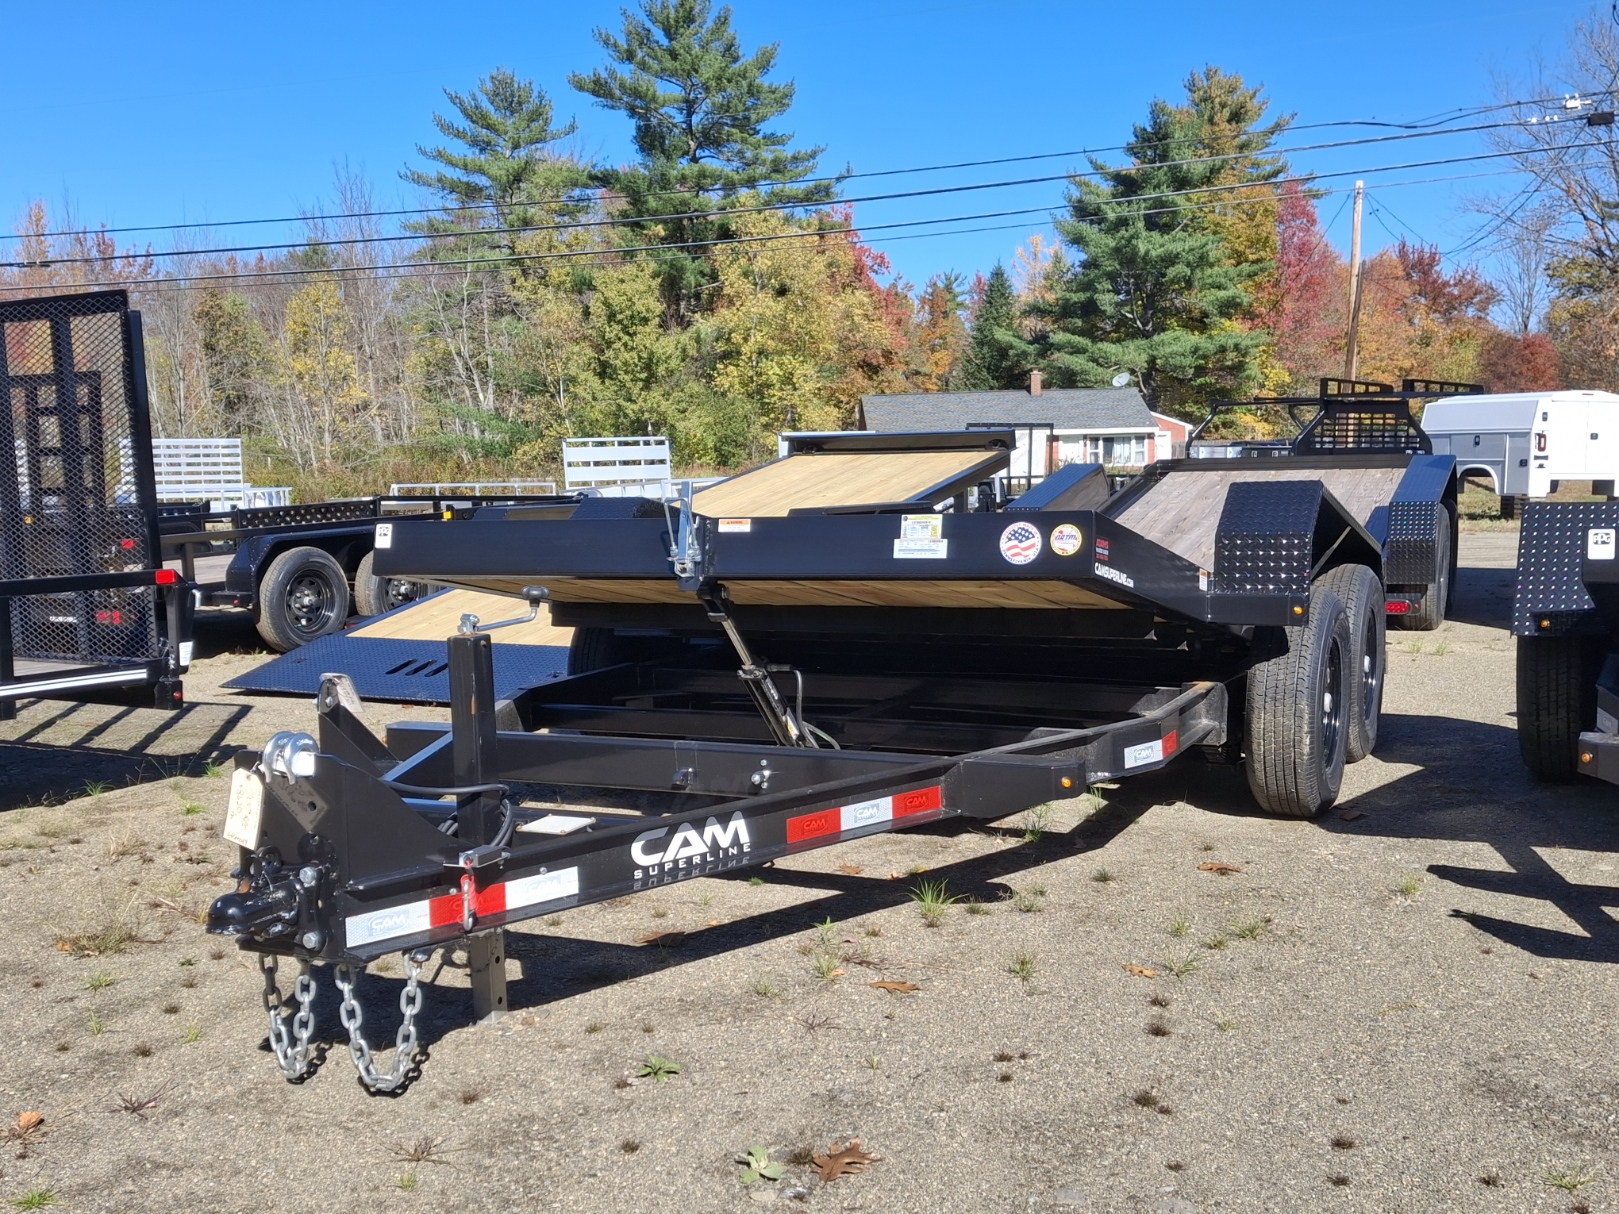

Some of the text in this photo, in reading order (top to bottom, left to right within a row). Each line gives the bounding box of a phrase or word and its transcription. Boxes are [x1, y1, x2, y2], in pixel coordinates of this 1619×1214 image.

[1592, 532, 1611, 546] PPG
[1136, 747, 1152, 758] CAM
[906, 795, 927, 806] CAM
[856, 806, 878, 818] CAM
[803, 819, 826, 830] CAM
[630, 811, 750, 867] CAM
[633, 842, 751, 879] SUPERLINE
[371, 913, 406, 929] CAM
